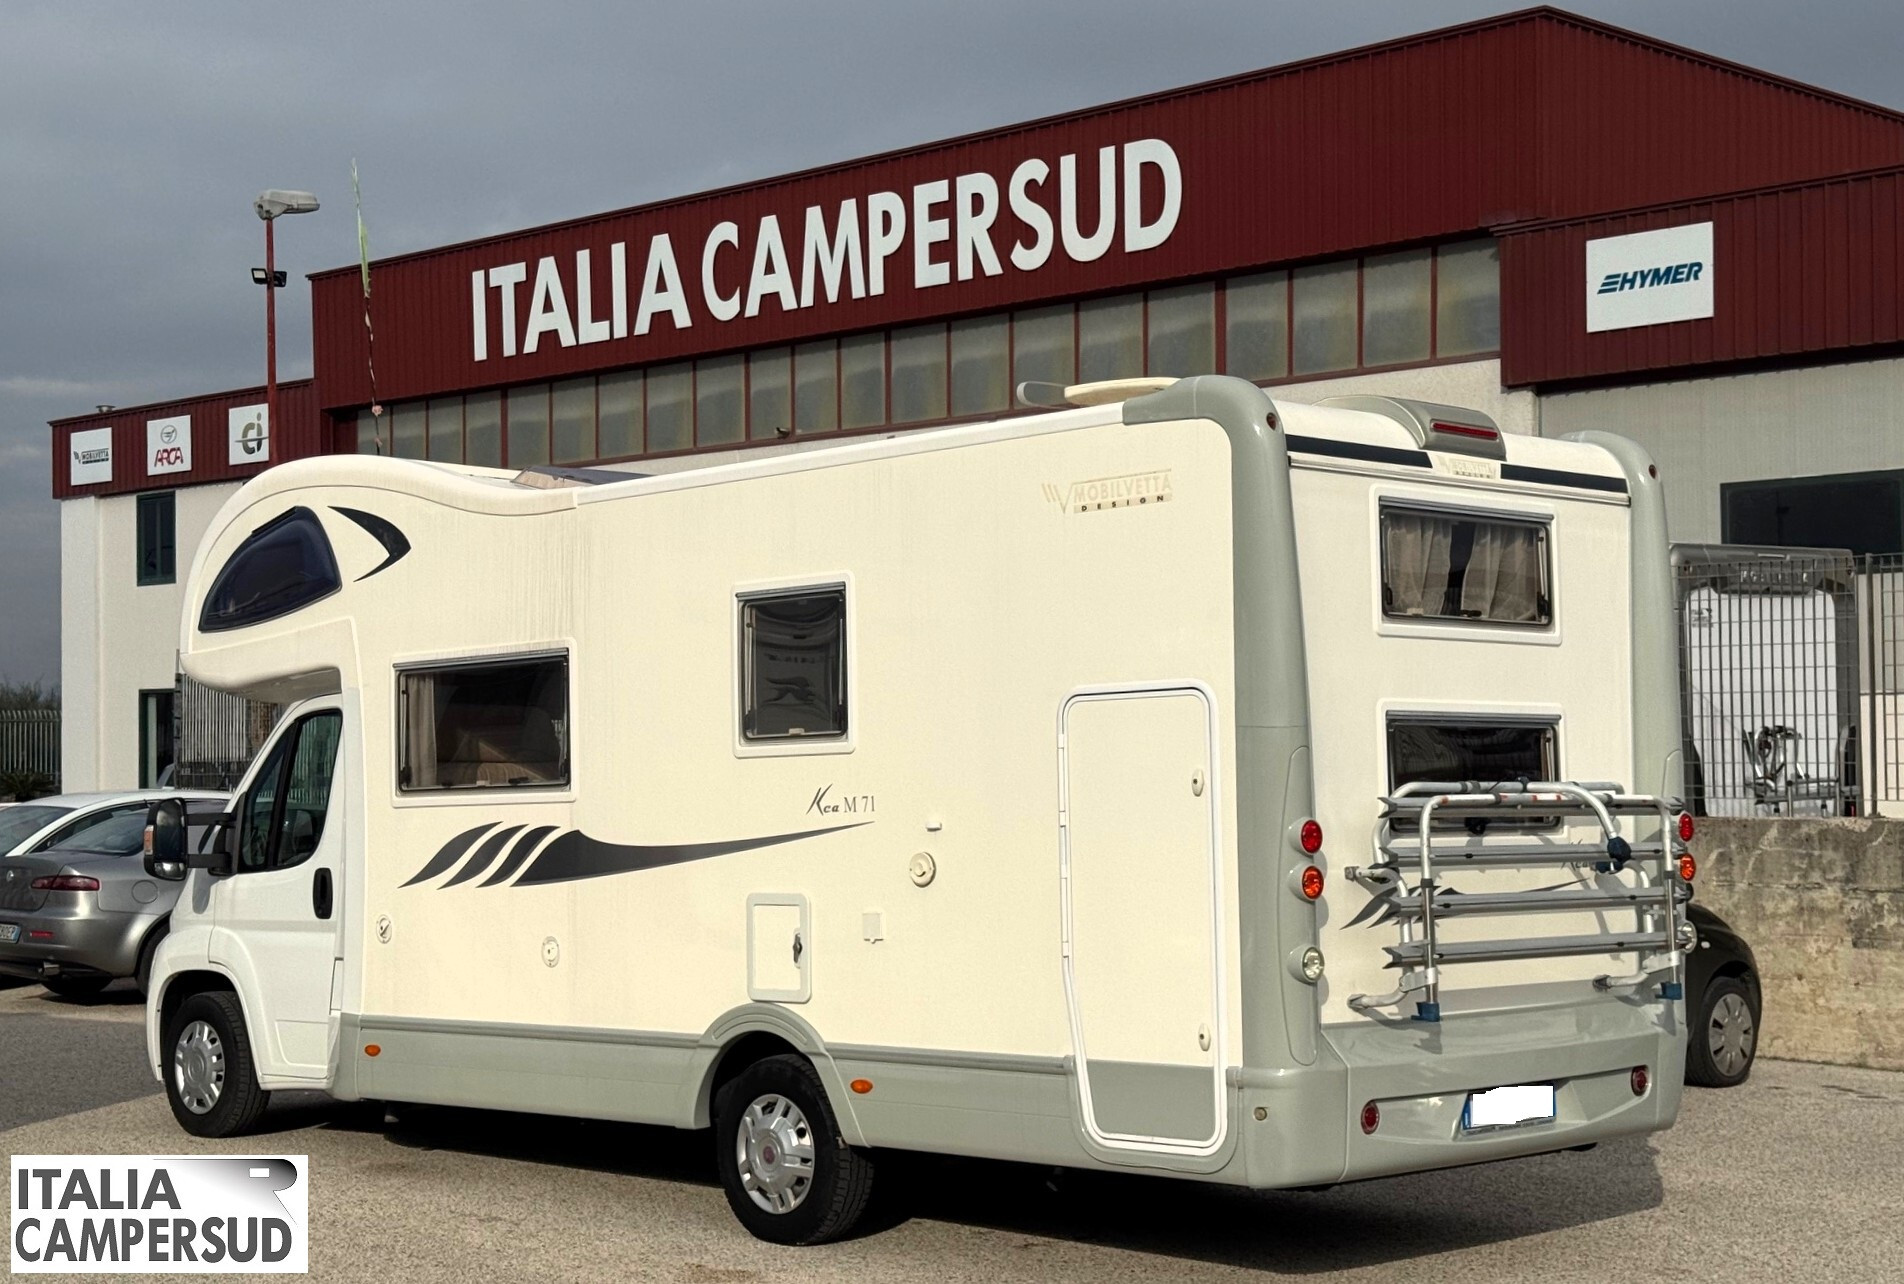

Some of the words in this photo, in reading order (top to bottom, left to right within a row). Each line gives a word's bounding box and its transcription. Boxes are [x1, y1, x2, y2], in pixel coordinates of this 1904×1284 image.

[471, 233, 692, 362] ITALIA
[702, 138, 1182, 322] CAMPERSUD
[1618, 261, 1703, 292] HYMER
[154, 446, 184, 468] ARCA
[1073, 473, 1173, 504] MOBILVETTA
[1081, 495, 1164, 512] DESIGN
[844, 795, 858, 813] M
[861, 795, 875, 812] 71
